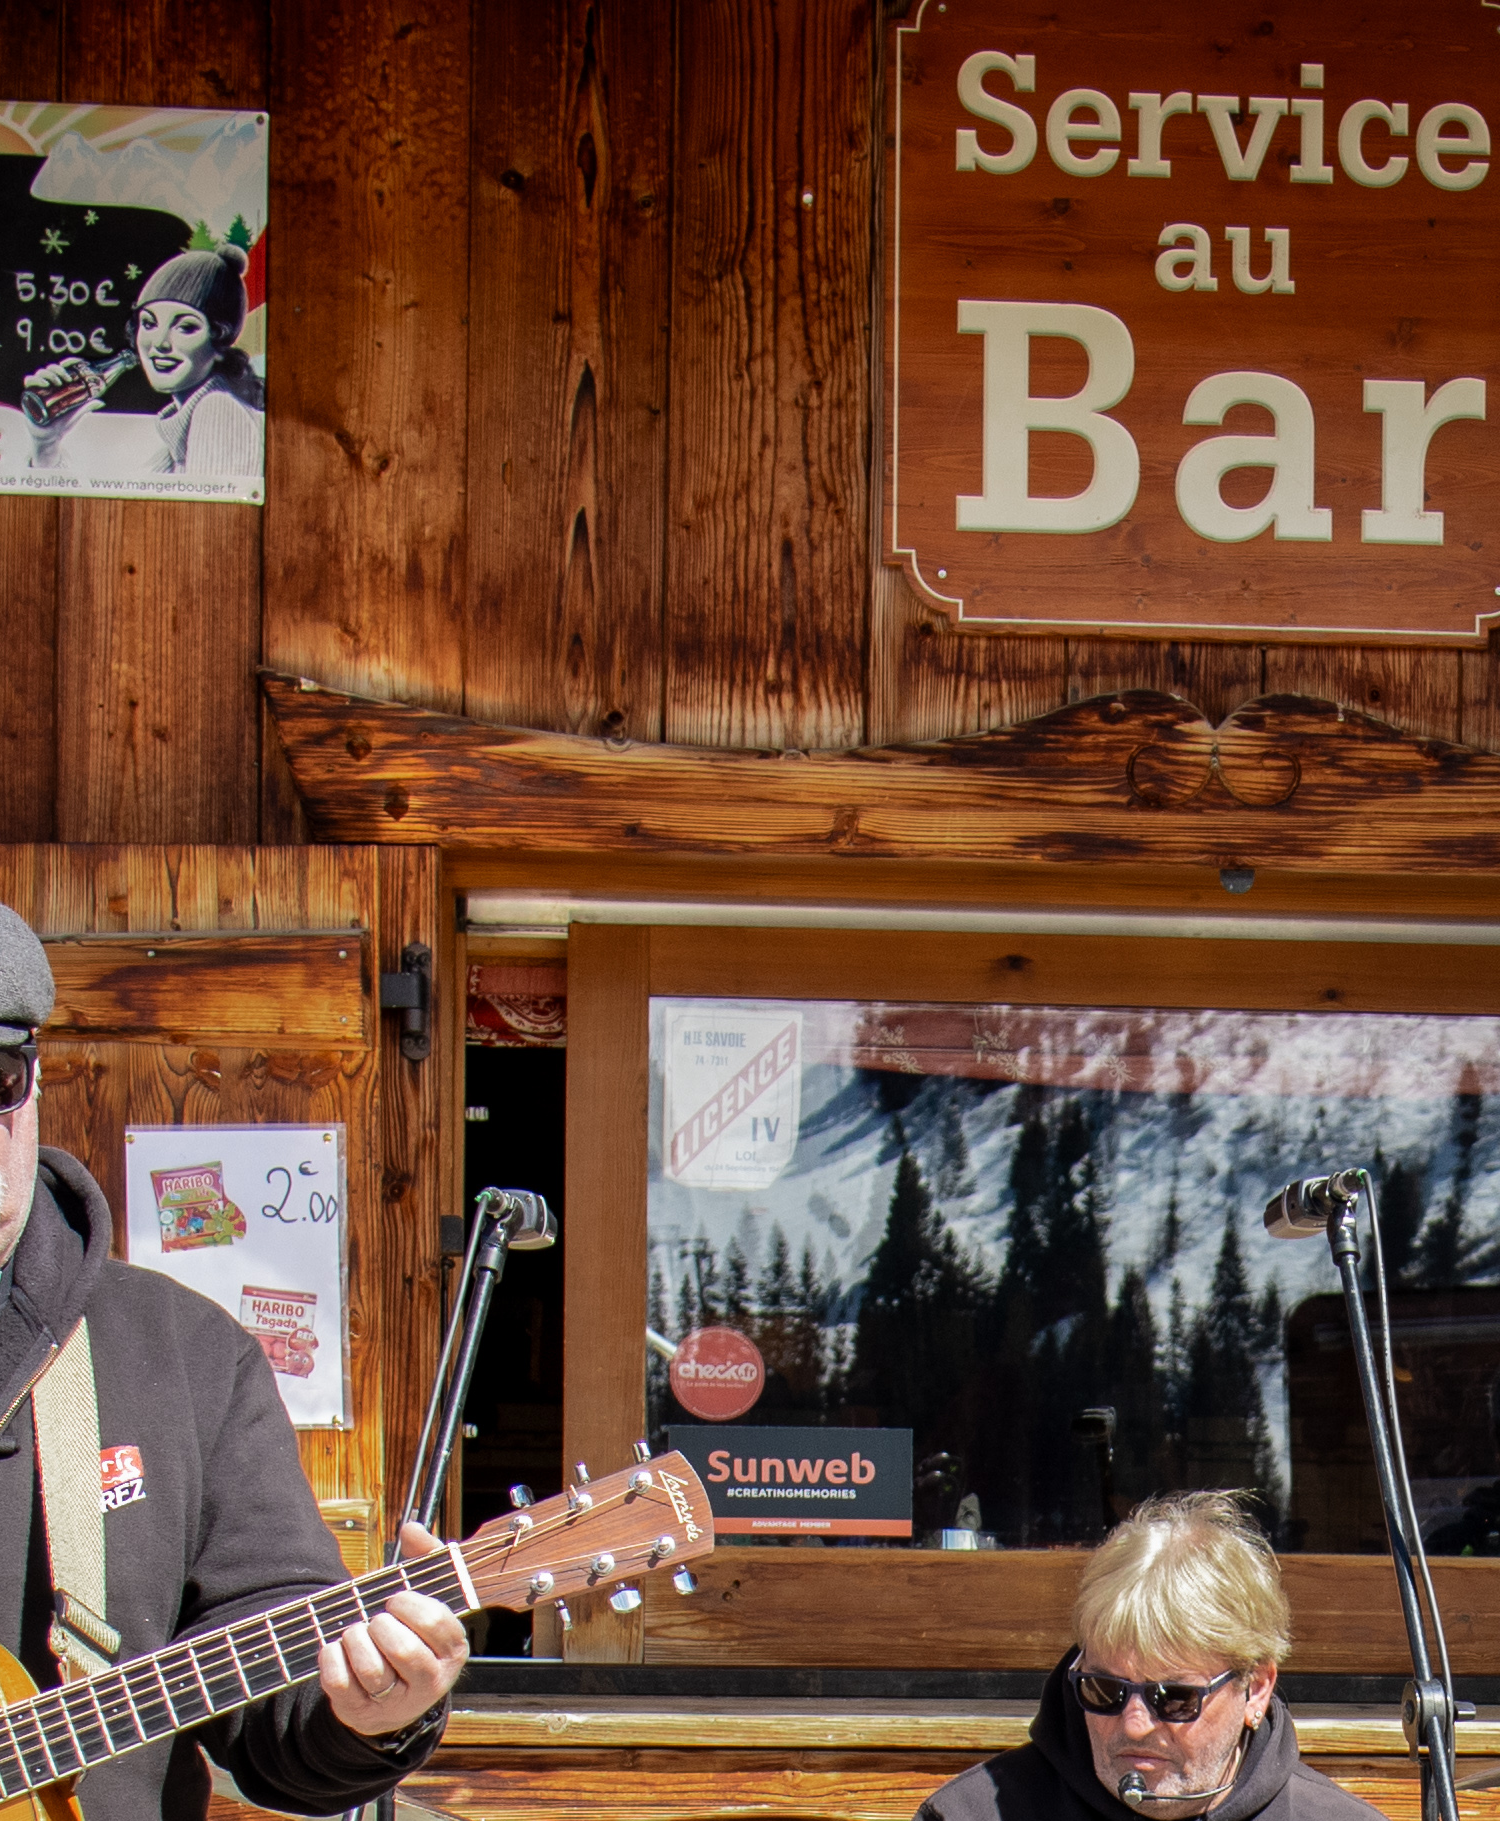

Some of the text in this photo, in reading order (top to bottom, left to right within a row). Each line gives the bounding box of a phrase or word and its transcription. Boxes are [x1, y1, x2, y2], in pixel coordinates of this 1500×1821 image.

[955, 50, 1492, 191] Service
[1153, 221, 1296, 295] au
[955, 299, 1487, 546] Bar
[21, 474, 82, 490] régulière.
[90, 478, 238, 495] www.mangerbouger.fr
[706, 1031, 747, 1048] SAVOIE
[677, 1031, 791, 1170] LICENCE
[752, 1117, 780, 1142] IV
[162, 1173, 213, 1193] HARIBO
[252, 1300, 305, 1318] HARIBO
[255, 1313, 298, 1331] Tagada
[707, 1450, 876, 1484] Sunweb
[727, 1487, 857, 1500] #CREATINGMEMORIES
